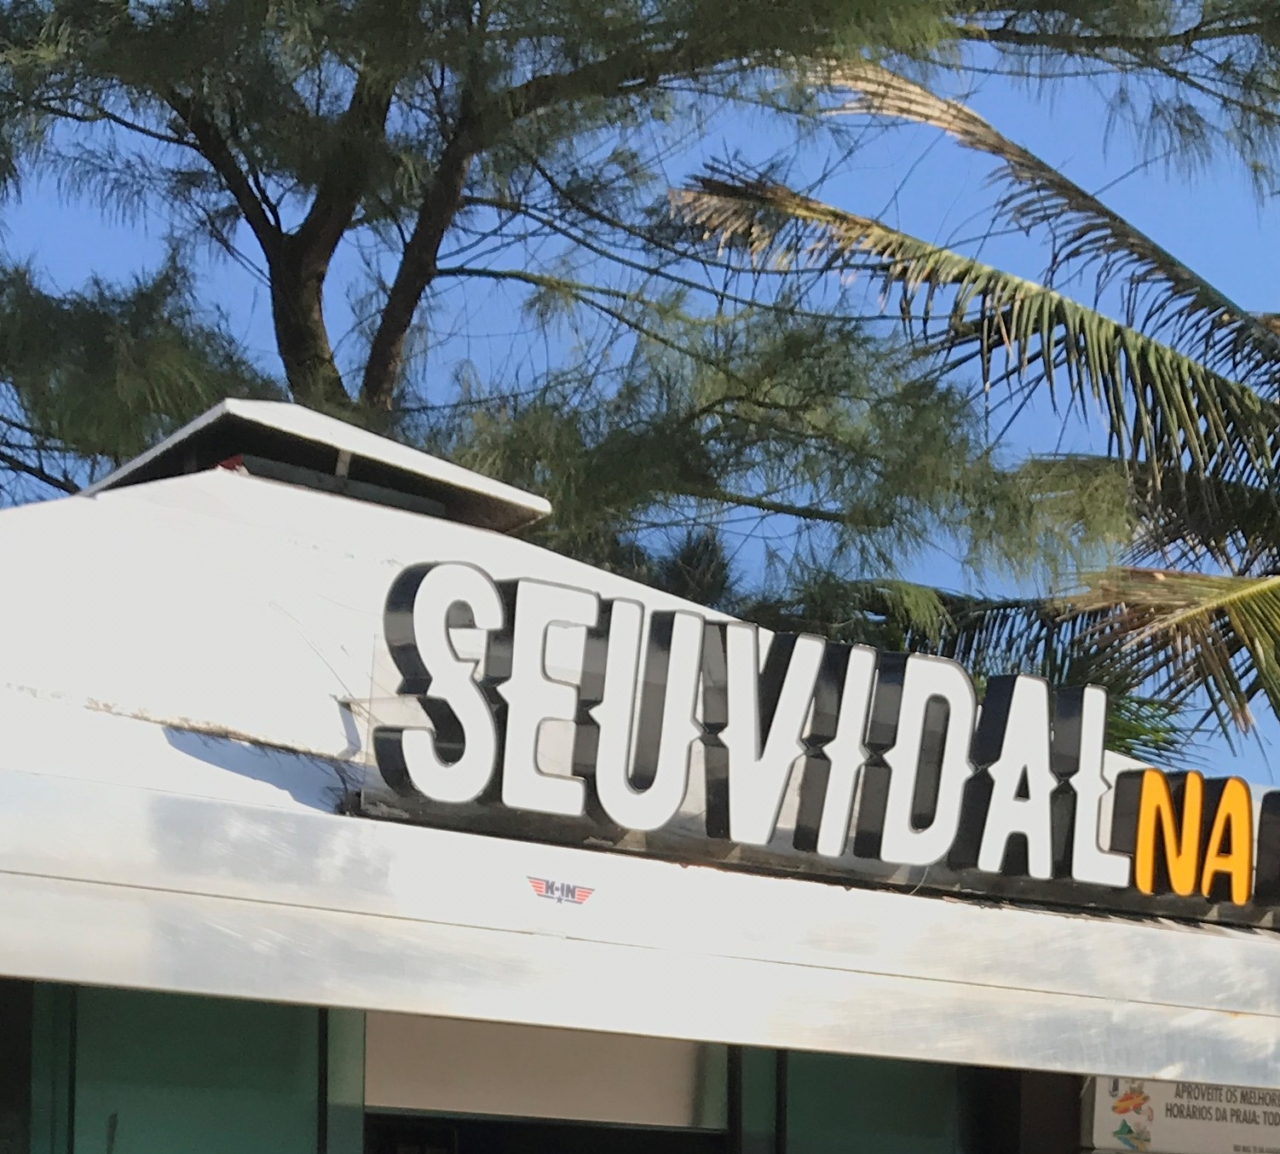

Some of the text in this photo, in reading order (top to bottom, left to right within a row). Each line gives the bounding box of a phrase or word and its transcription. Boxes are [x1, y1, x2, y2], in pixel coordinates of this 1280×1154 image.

[1133, 767, 1252, 907] NA
[1174, 1082, 1223, 1103] APROVEITE
[1225, 1088, 1238, 1104] OS
[1215, 1107, 1228, 1123] DA
[1230, 1108, 1260, 1125] PRAIA:
